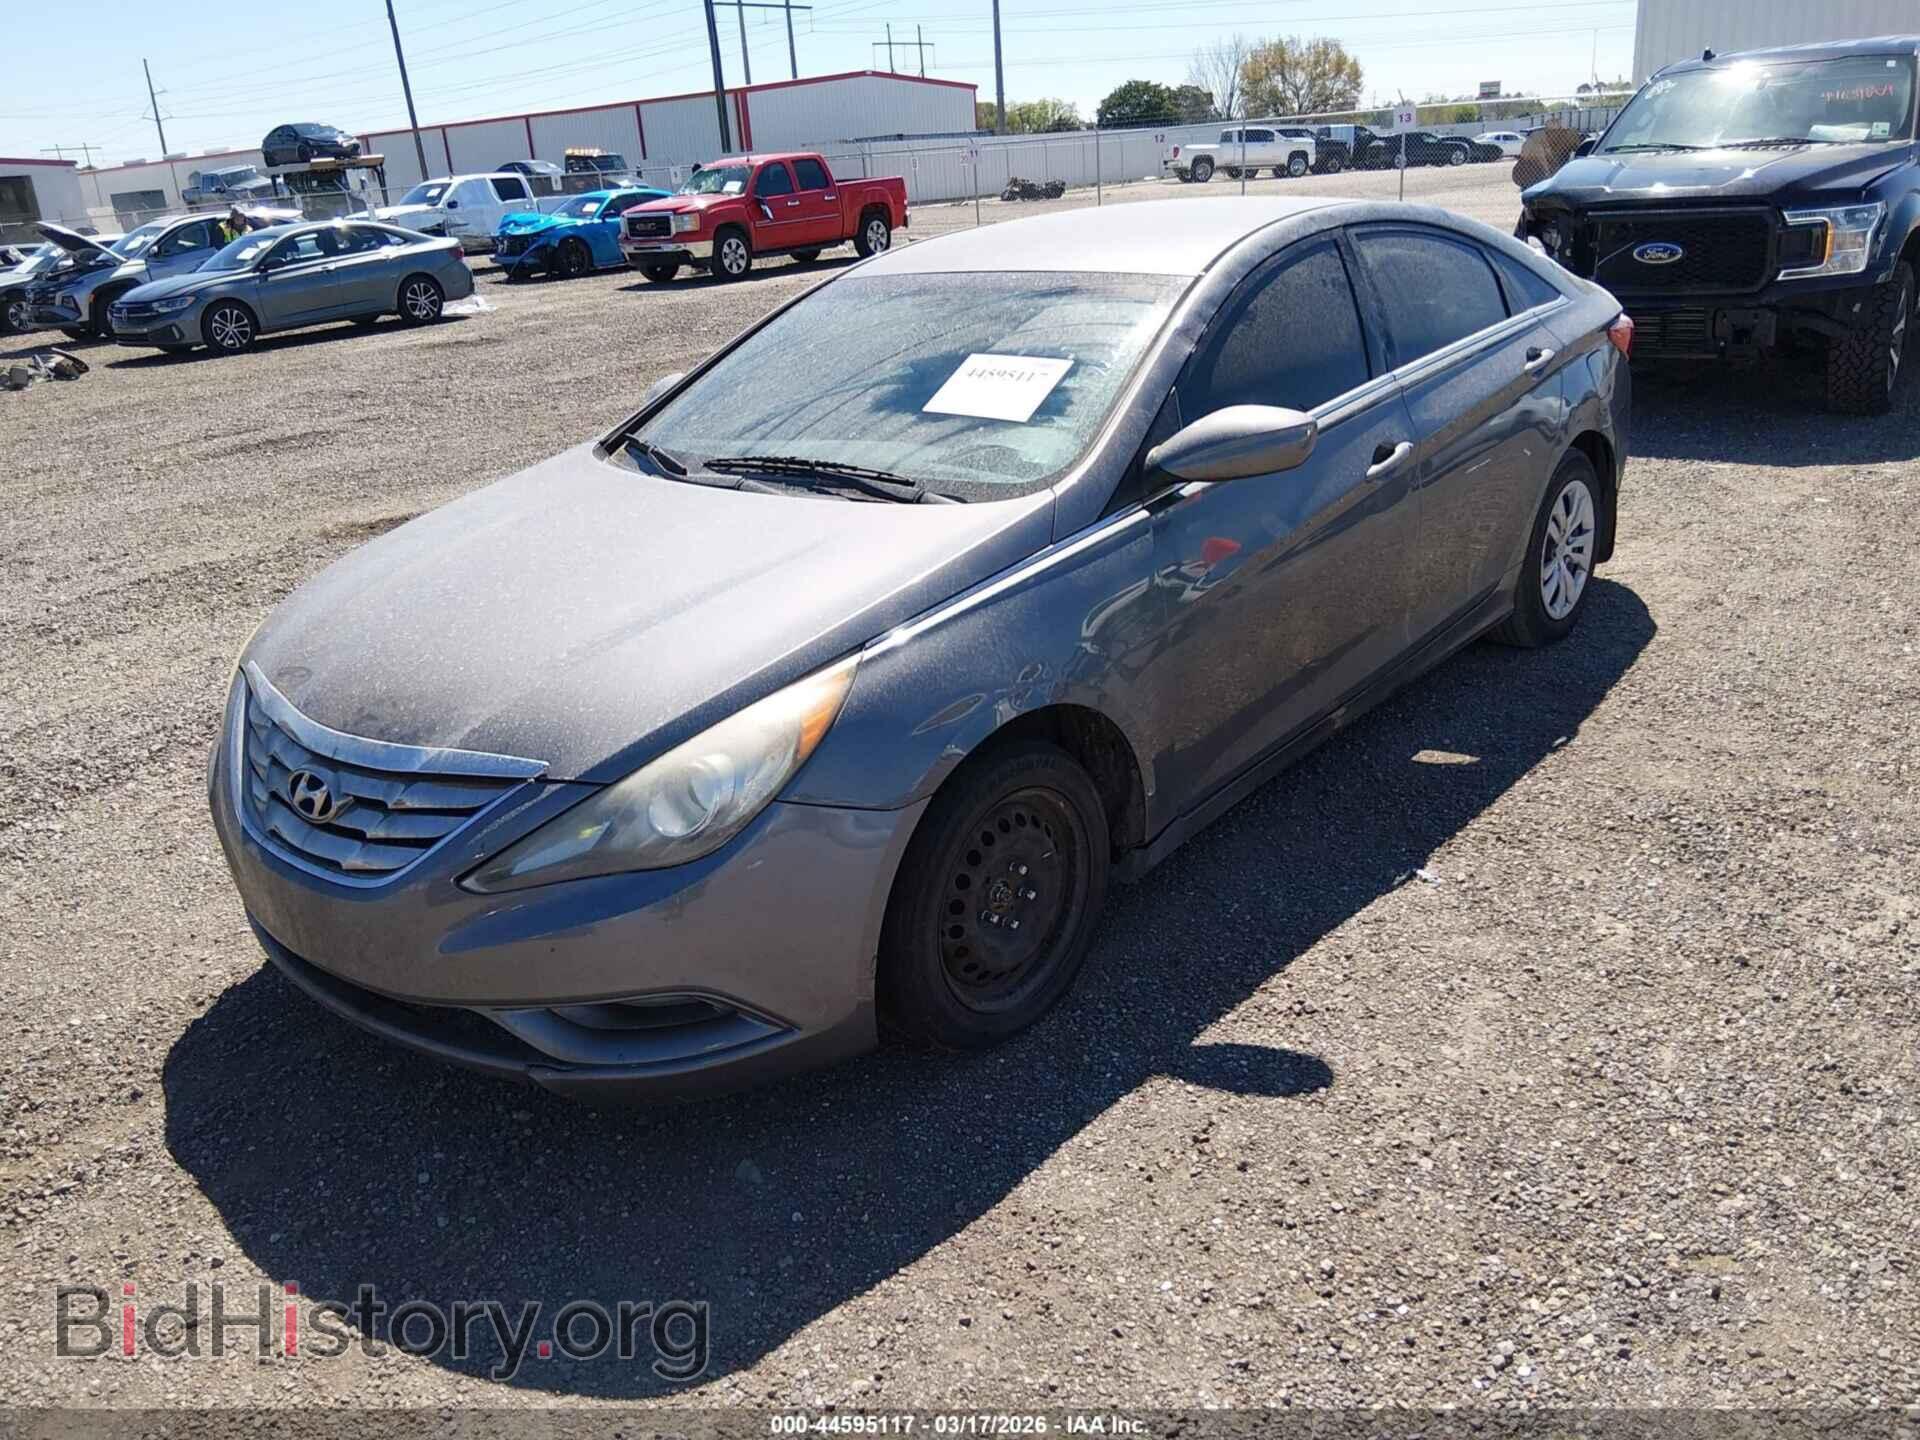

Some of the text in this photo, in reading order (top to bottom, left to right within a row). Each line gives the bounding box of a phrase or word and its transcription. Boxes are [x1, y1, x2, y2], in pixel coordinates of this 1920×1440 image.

[1399, 111, 1412, 123] 13
[1154, 133, 1166, 144] 12
[1643, 247, 1672, 260] Ford
